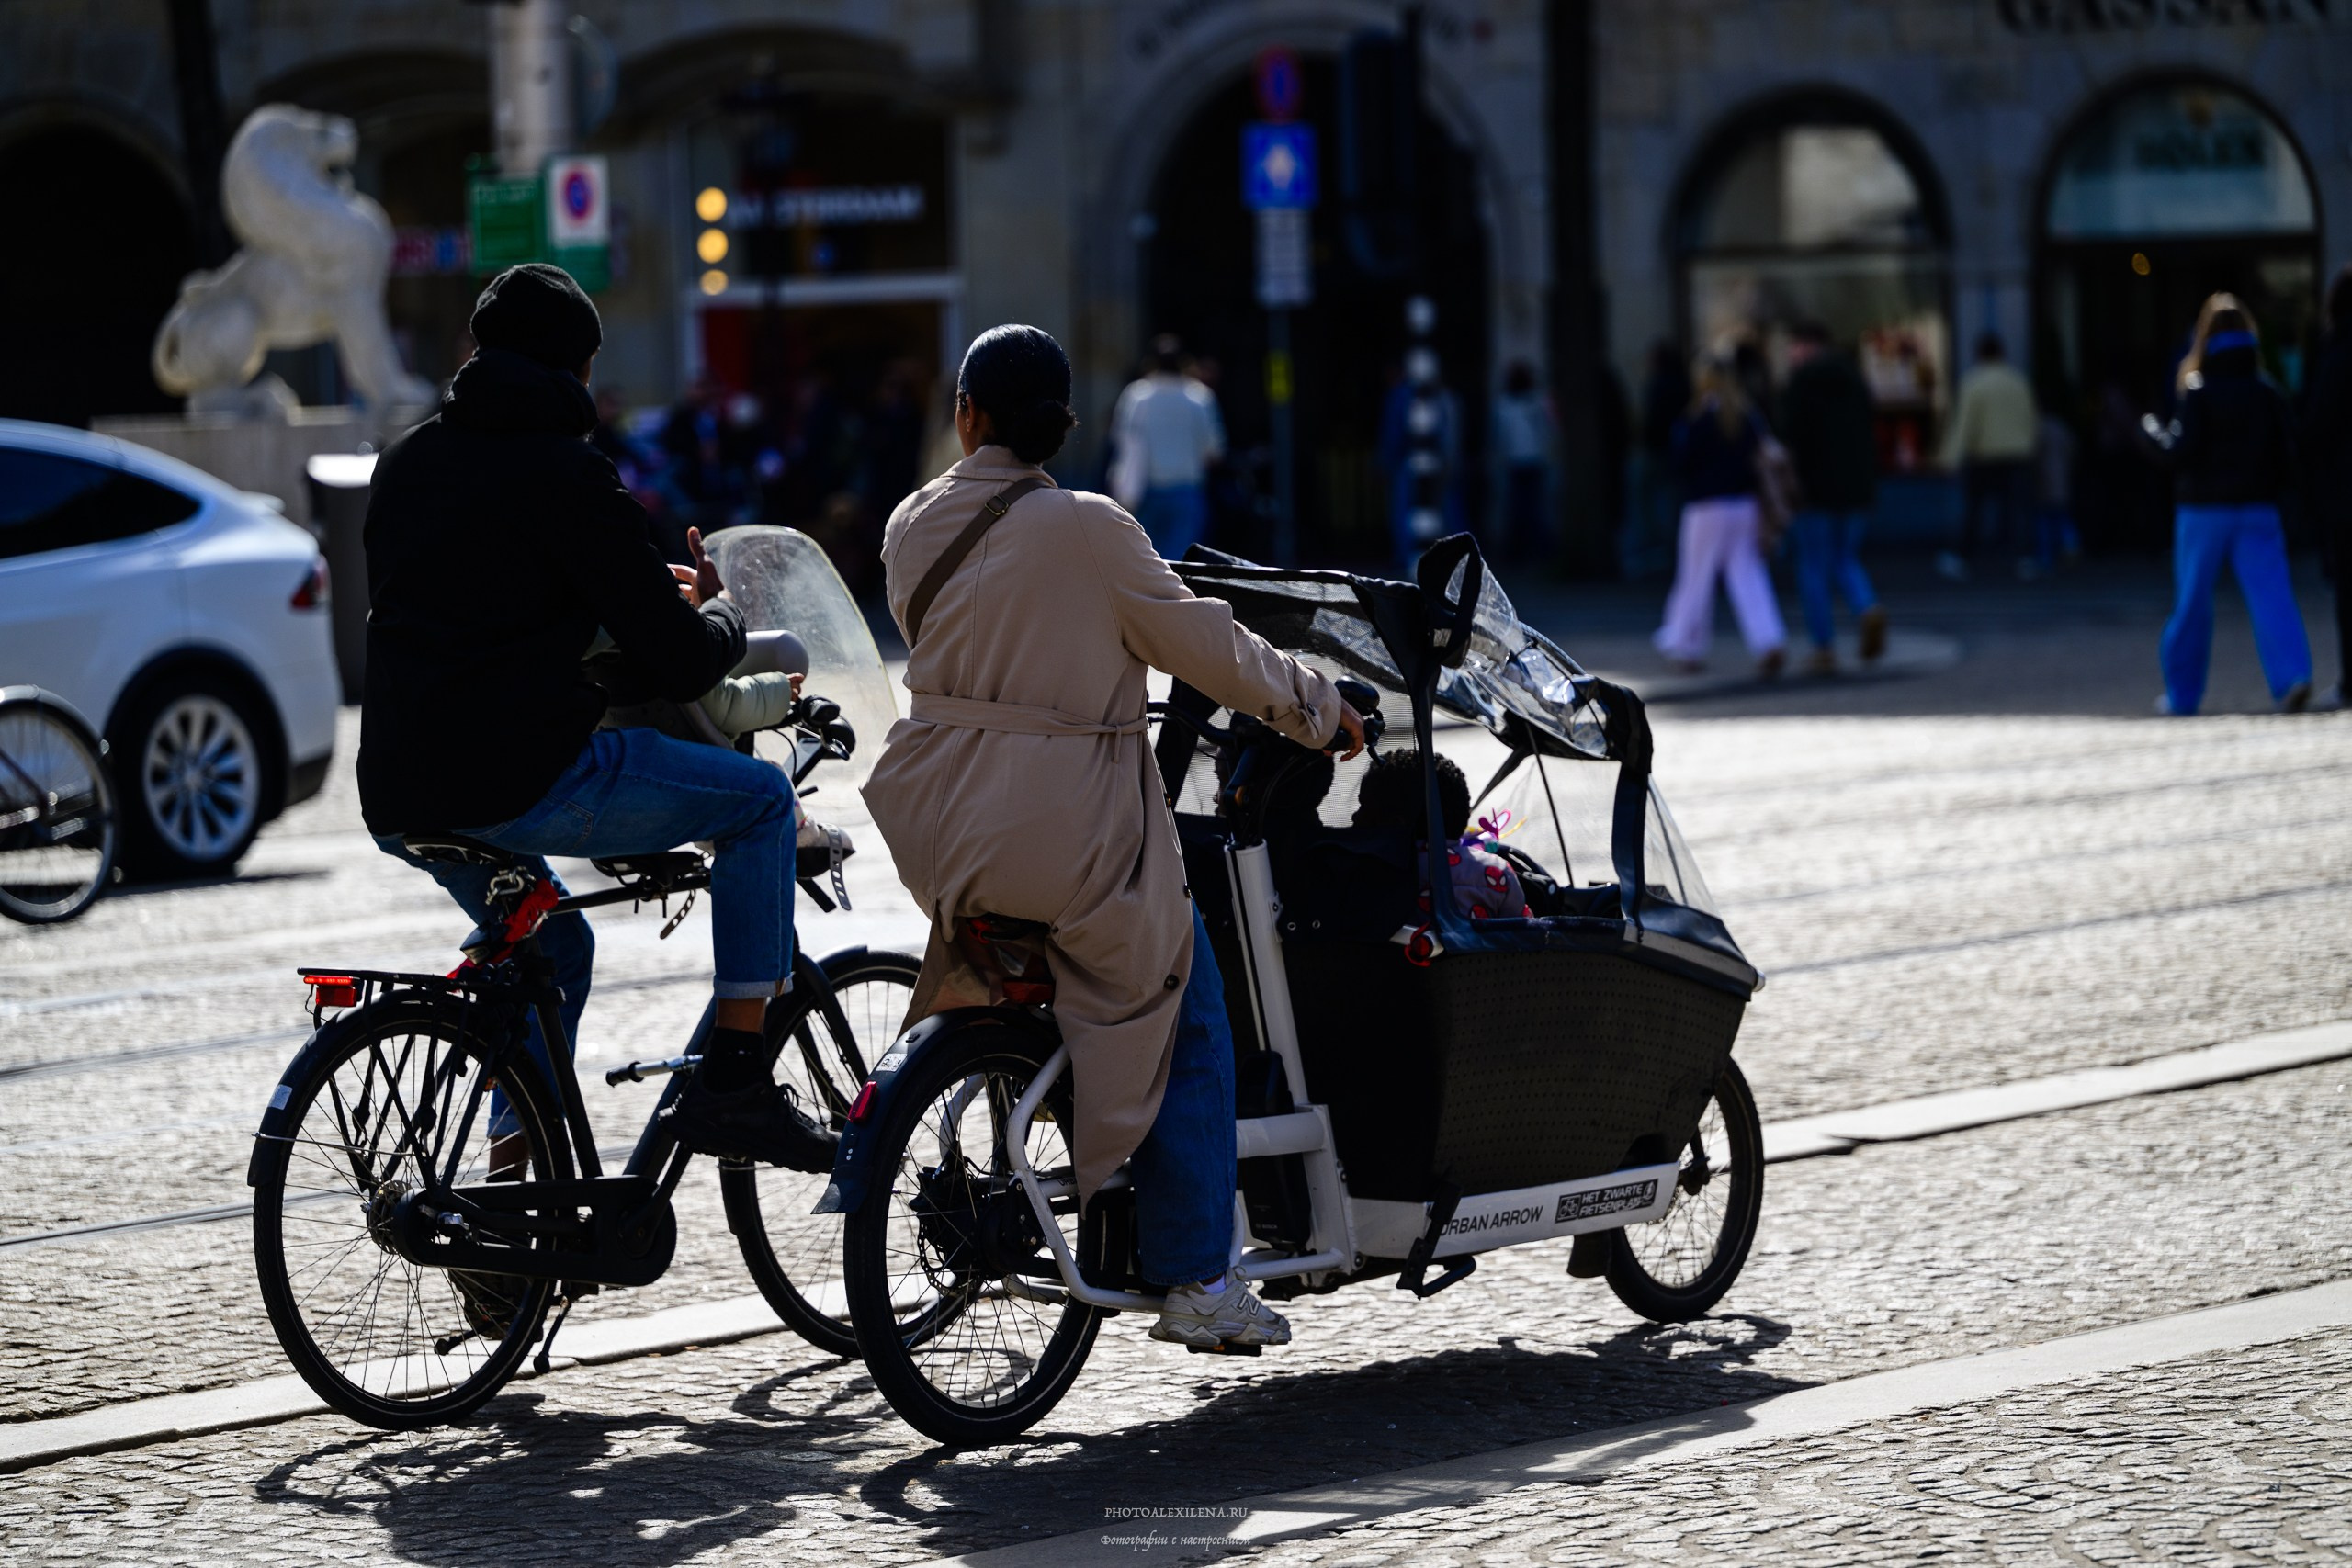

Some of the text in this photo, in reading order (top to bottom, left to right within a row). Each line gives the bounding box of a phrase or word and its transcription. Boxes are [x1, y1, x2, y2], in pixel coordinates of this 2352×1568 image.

[1582, 1183, 1644, 1204] HET ZWARTE
[1489, 1205, 1544, 1229] ARROW
